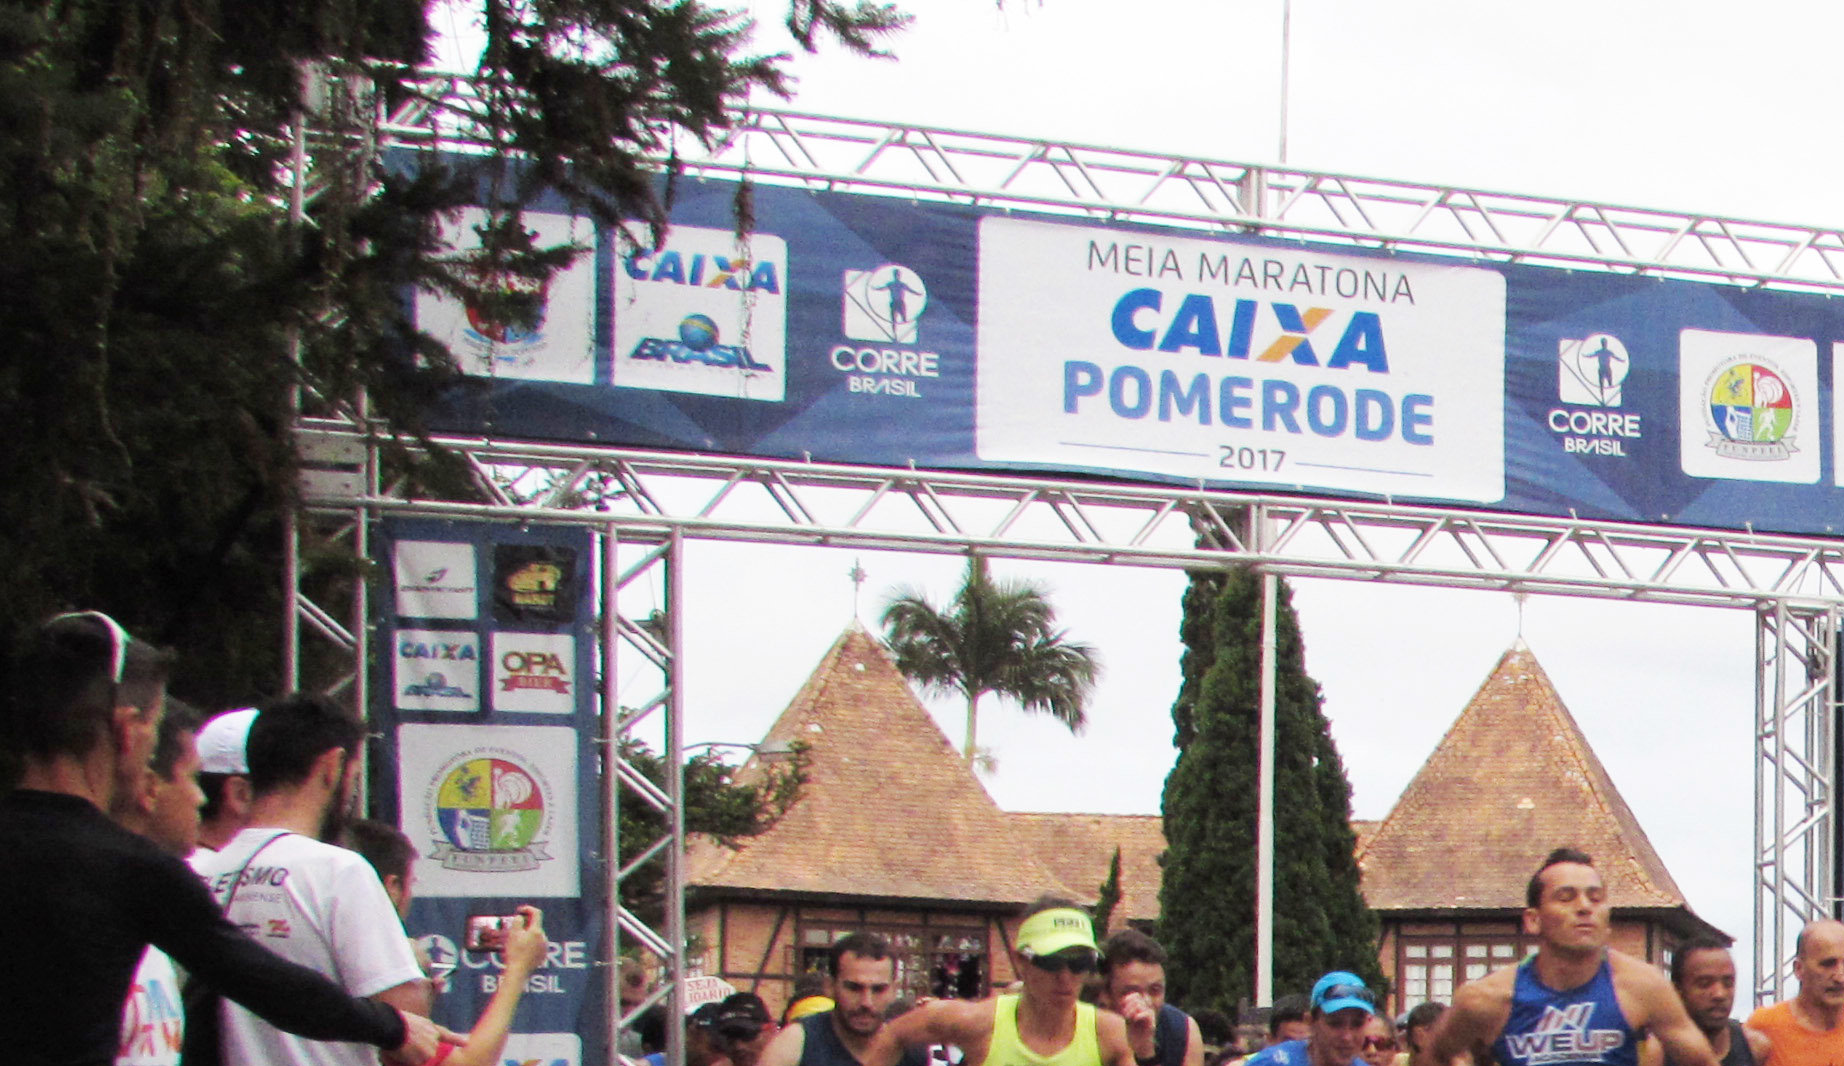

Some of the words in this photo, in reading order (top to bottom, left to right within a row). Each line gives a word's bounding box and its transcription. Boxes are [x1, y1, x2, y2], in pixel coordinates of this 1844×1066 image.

[625, 247, 780, 295] CAIXA
[1087, 240, 1184, 281] MEIA
[1198, 251, 1416, 305] MARATONA
[1110, 287, 1391, 375] CAIXA
[831, 345, 940, 378] CORRE
[849, 376, 922, 398] BRASIL
[1063, 359, 1435, 446] POMERODE
[1548, 408, 1642, 438] CORRE
[1219, 445, 1287, 473] 2017
[1564, 436, 1628, 457] BRASIL
[398, 640, 477, 661] CAIXA
[503, 651, 567, 676] OPA
